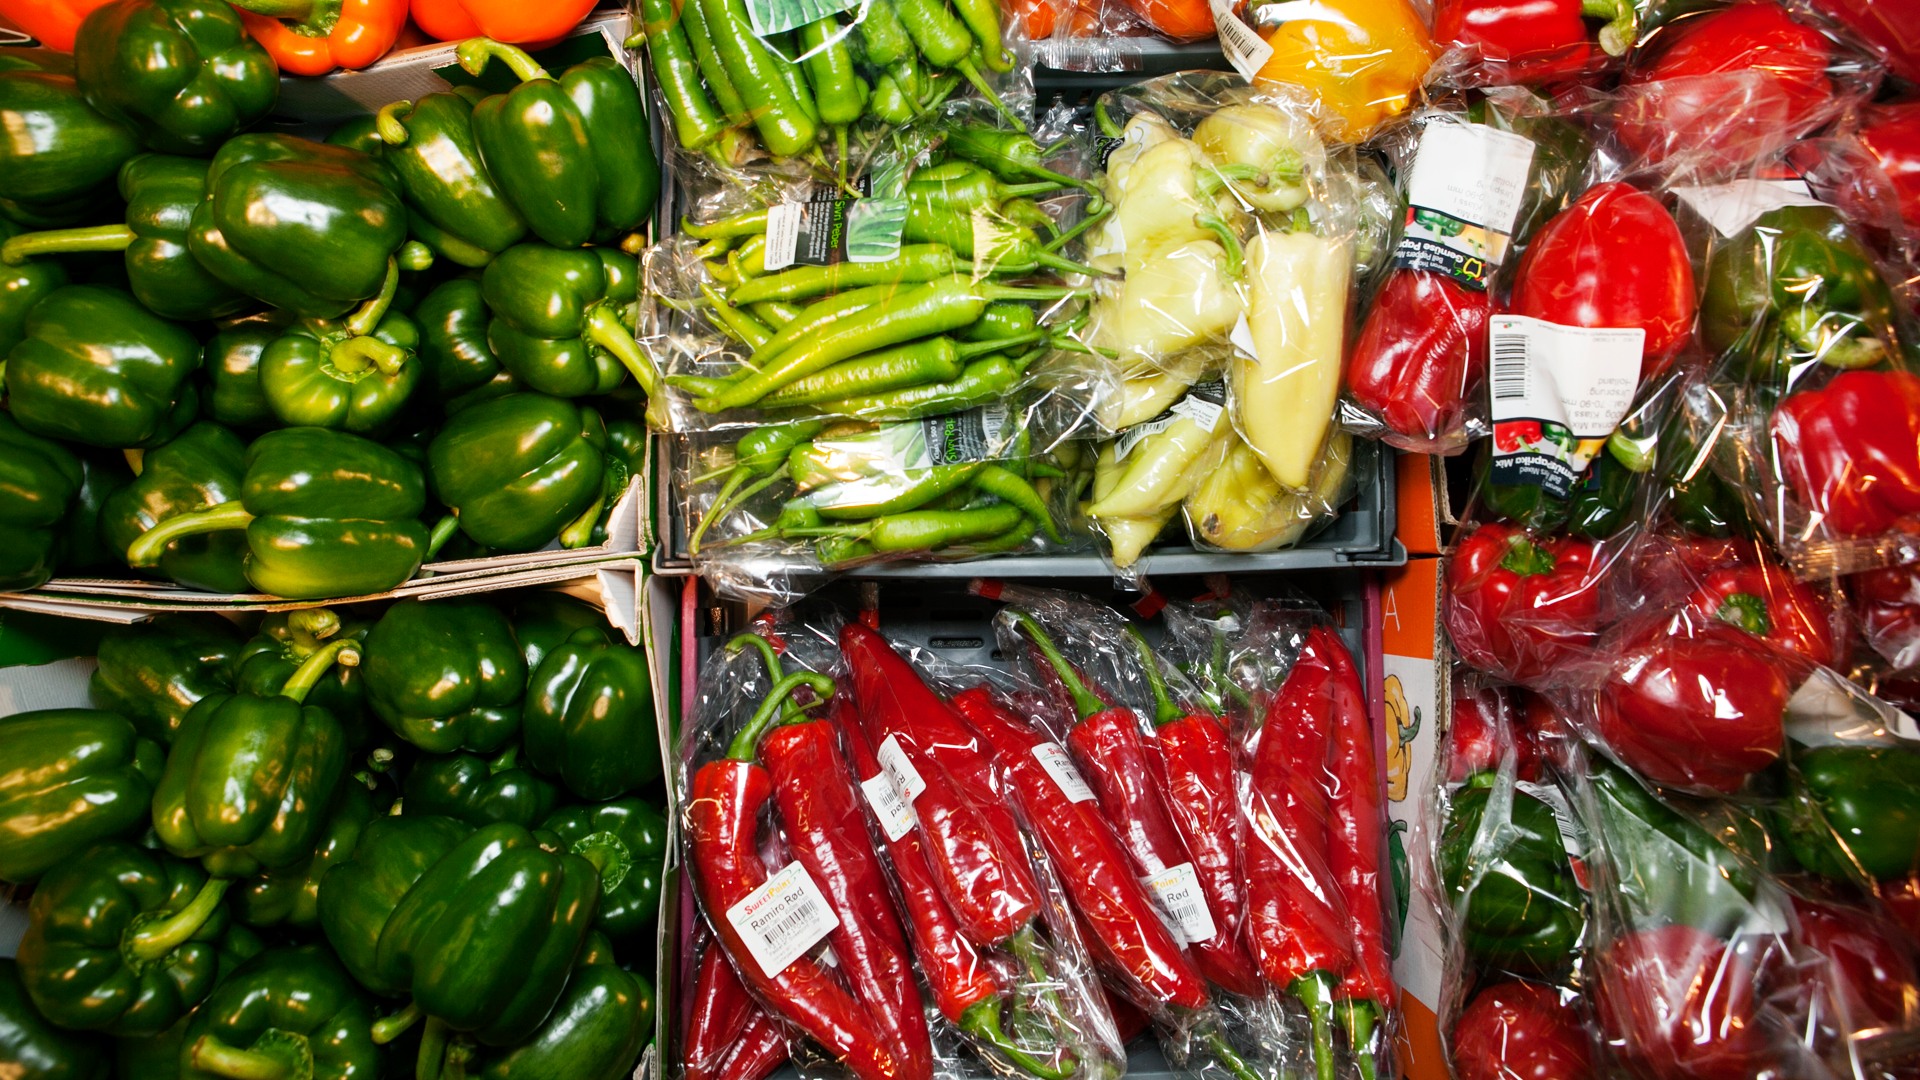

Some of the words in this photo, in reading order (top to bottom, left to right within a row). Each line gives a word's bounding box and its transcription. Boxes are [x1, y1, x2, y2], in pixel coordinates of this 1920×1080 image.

[833, 200, 846, 221] Sivri
[830, 222, 842, 249] Peber
[1406, 250, 1432, 261] Peppers
[1423, 242, 1464, 264] Gemüse
[1432, 254, 1444, 264] Bell
[1408, 259, 1429, 268] Tricor
[1495, 458, 1514, 468] Mix
[1515, 456, 1554, 469] Paprika
[1519, 466, 1540, 475] Mixed
[1548, 473, 1562, 484] Bell
[1166, 888, 1190, 904] Rød
[750, 902, 786, 932] Ramiro
[784, 886, 805, 905] Rød
